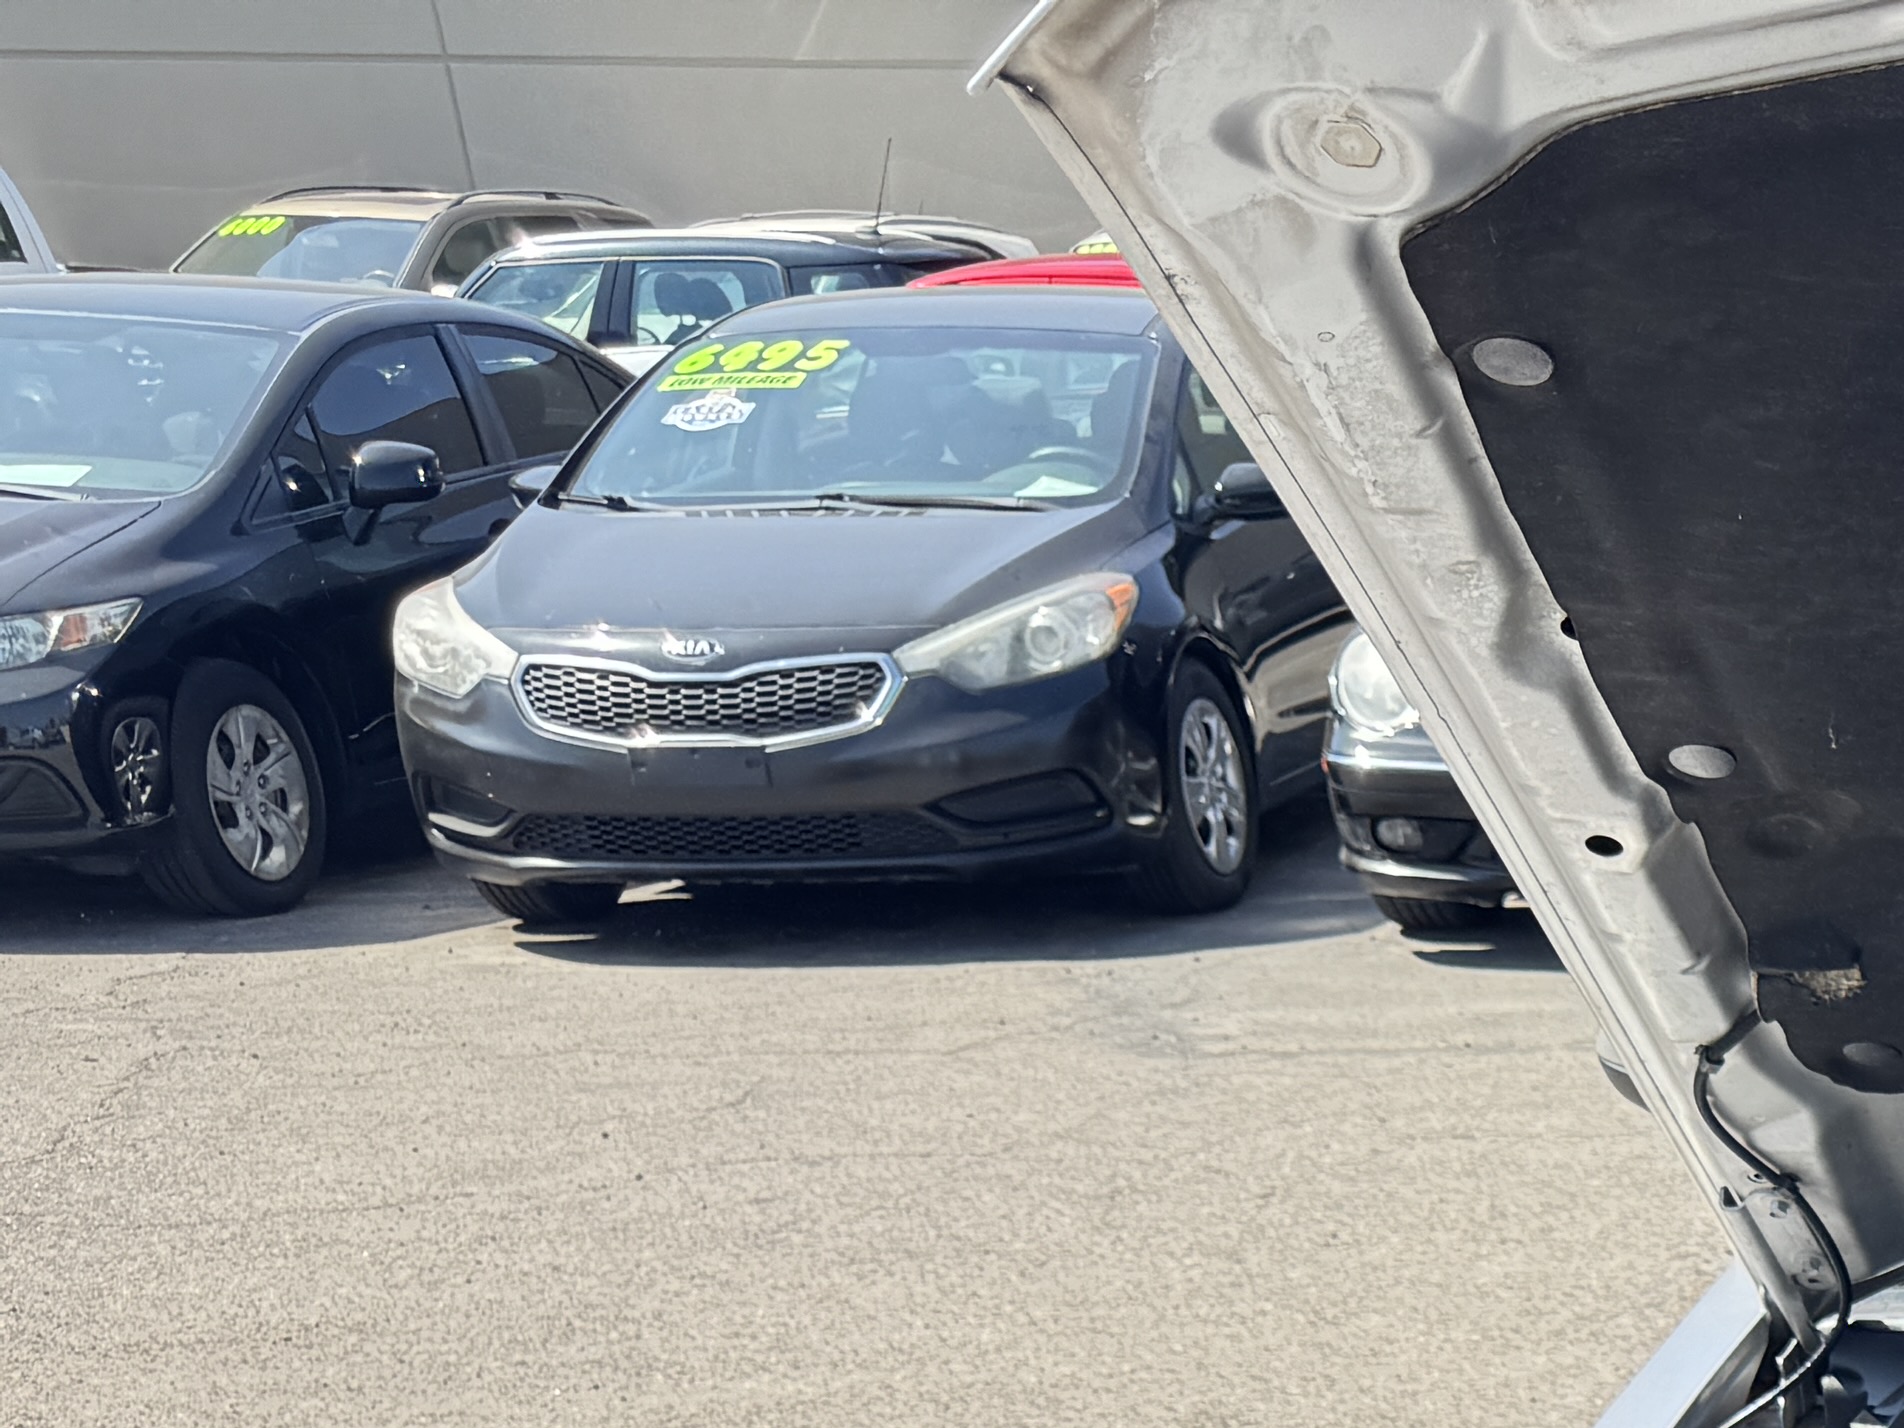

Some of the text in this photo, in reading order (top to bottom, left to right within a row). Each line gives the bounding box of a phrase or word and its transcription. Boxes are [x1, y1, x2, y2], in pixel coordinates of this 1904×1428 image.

[674, 339, 850, 375] 6495
[669, 373, 798, 388] LOW MILEAGE
